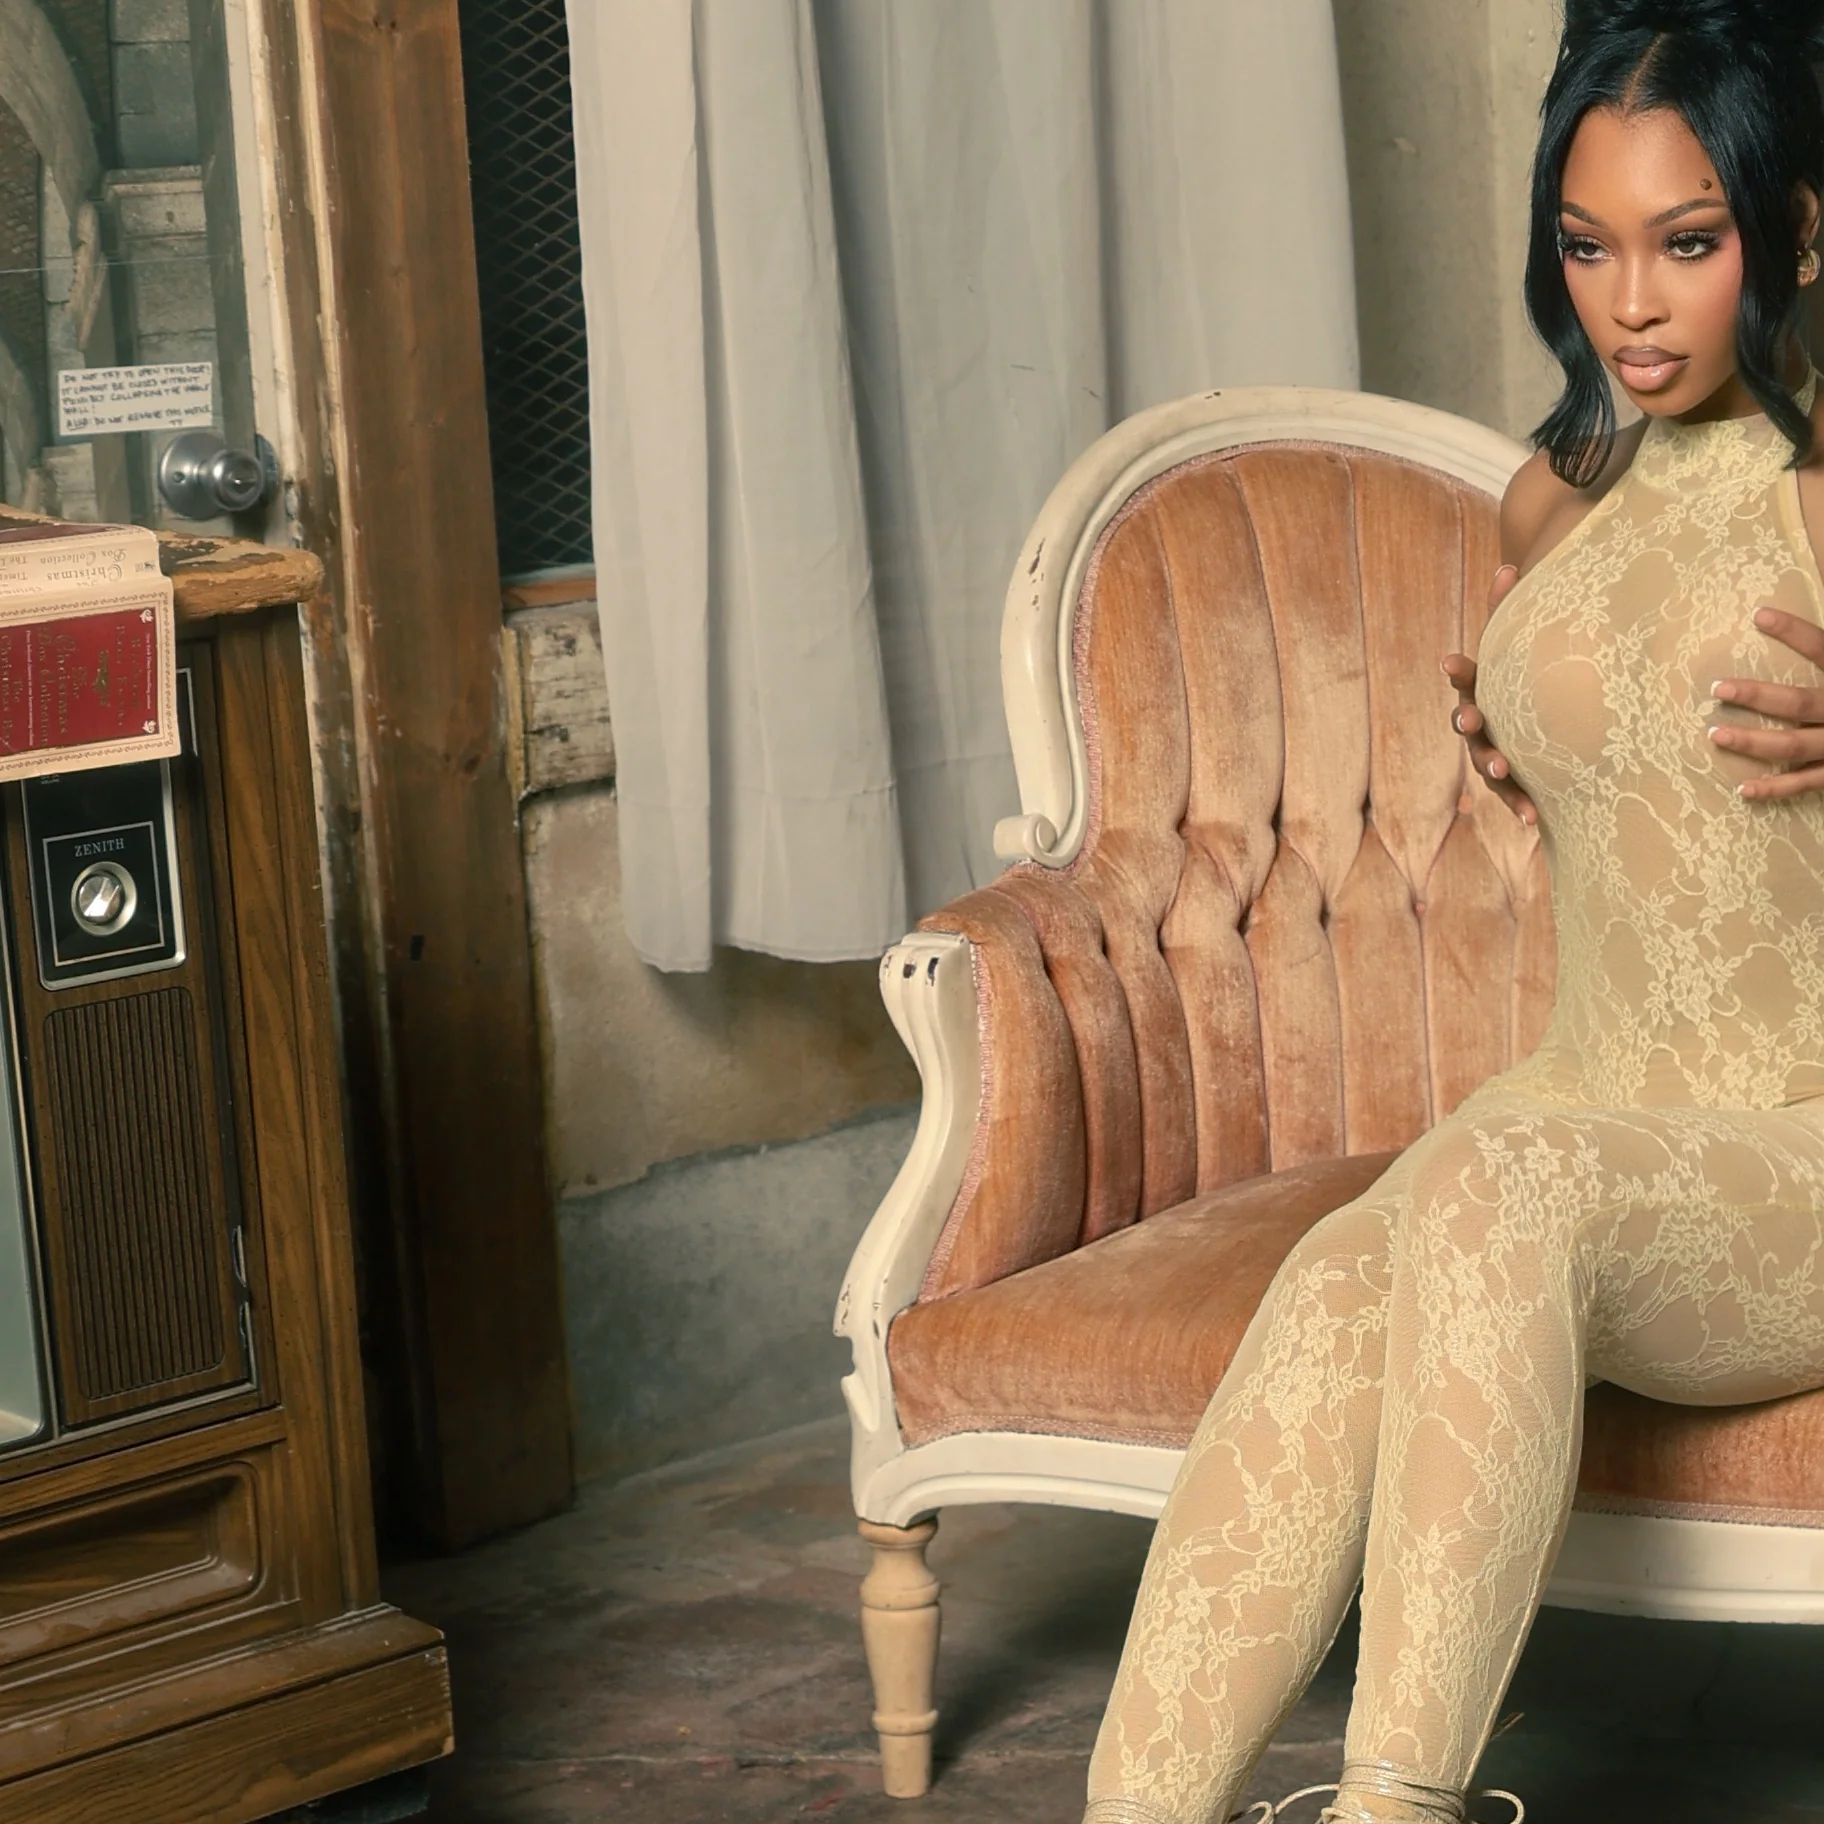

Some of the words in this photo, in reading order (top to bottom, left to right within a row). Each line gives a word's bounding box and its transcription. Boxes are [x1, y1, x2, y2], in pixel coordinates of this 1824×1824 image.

[39, 551, 96, 567] Collection
[101, 549, 126, 563] Box
[46, 564, 122, 582] Christmas
[74, 837, 125, 858] ZENITH
